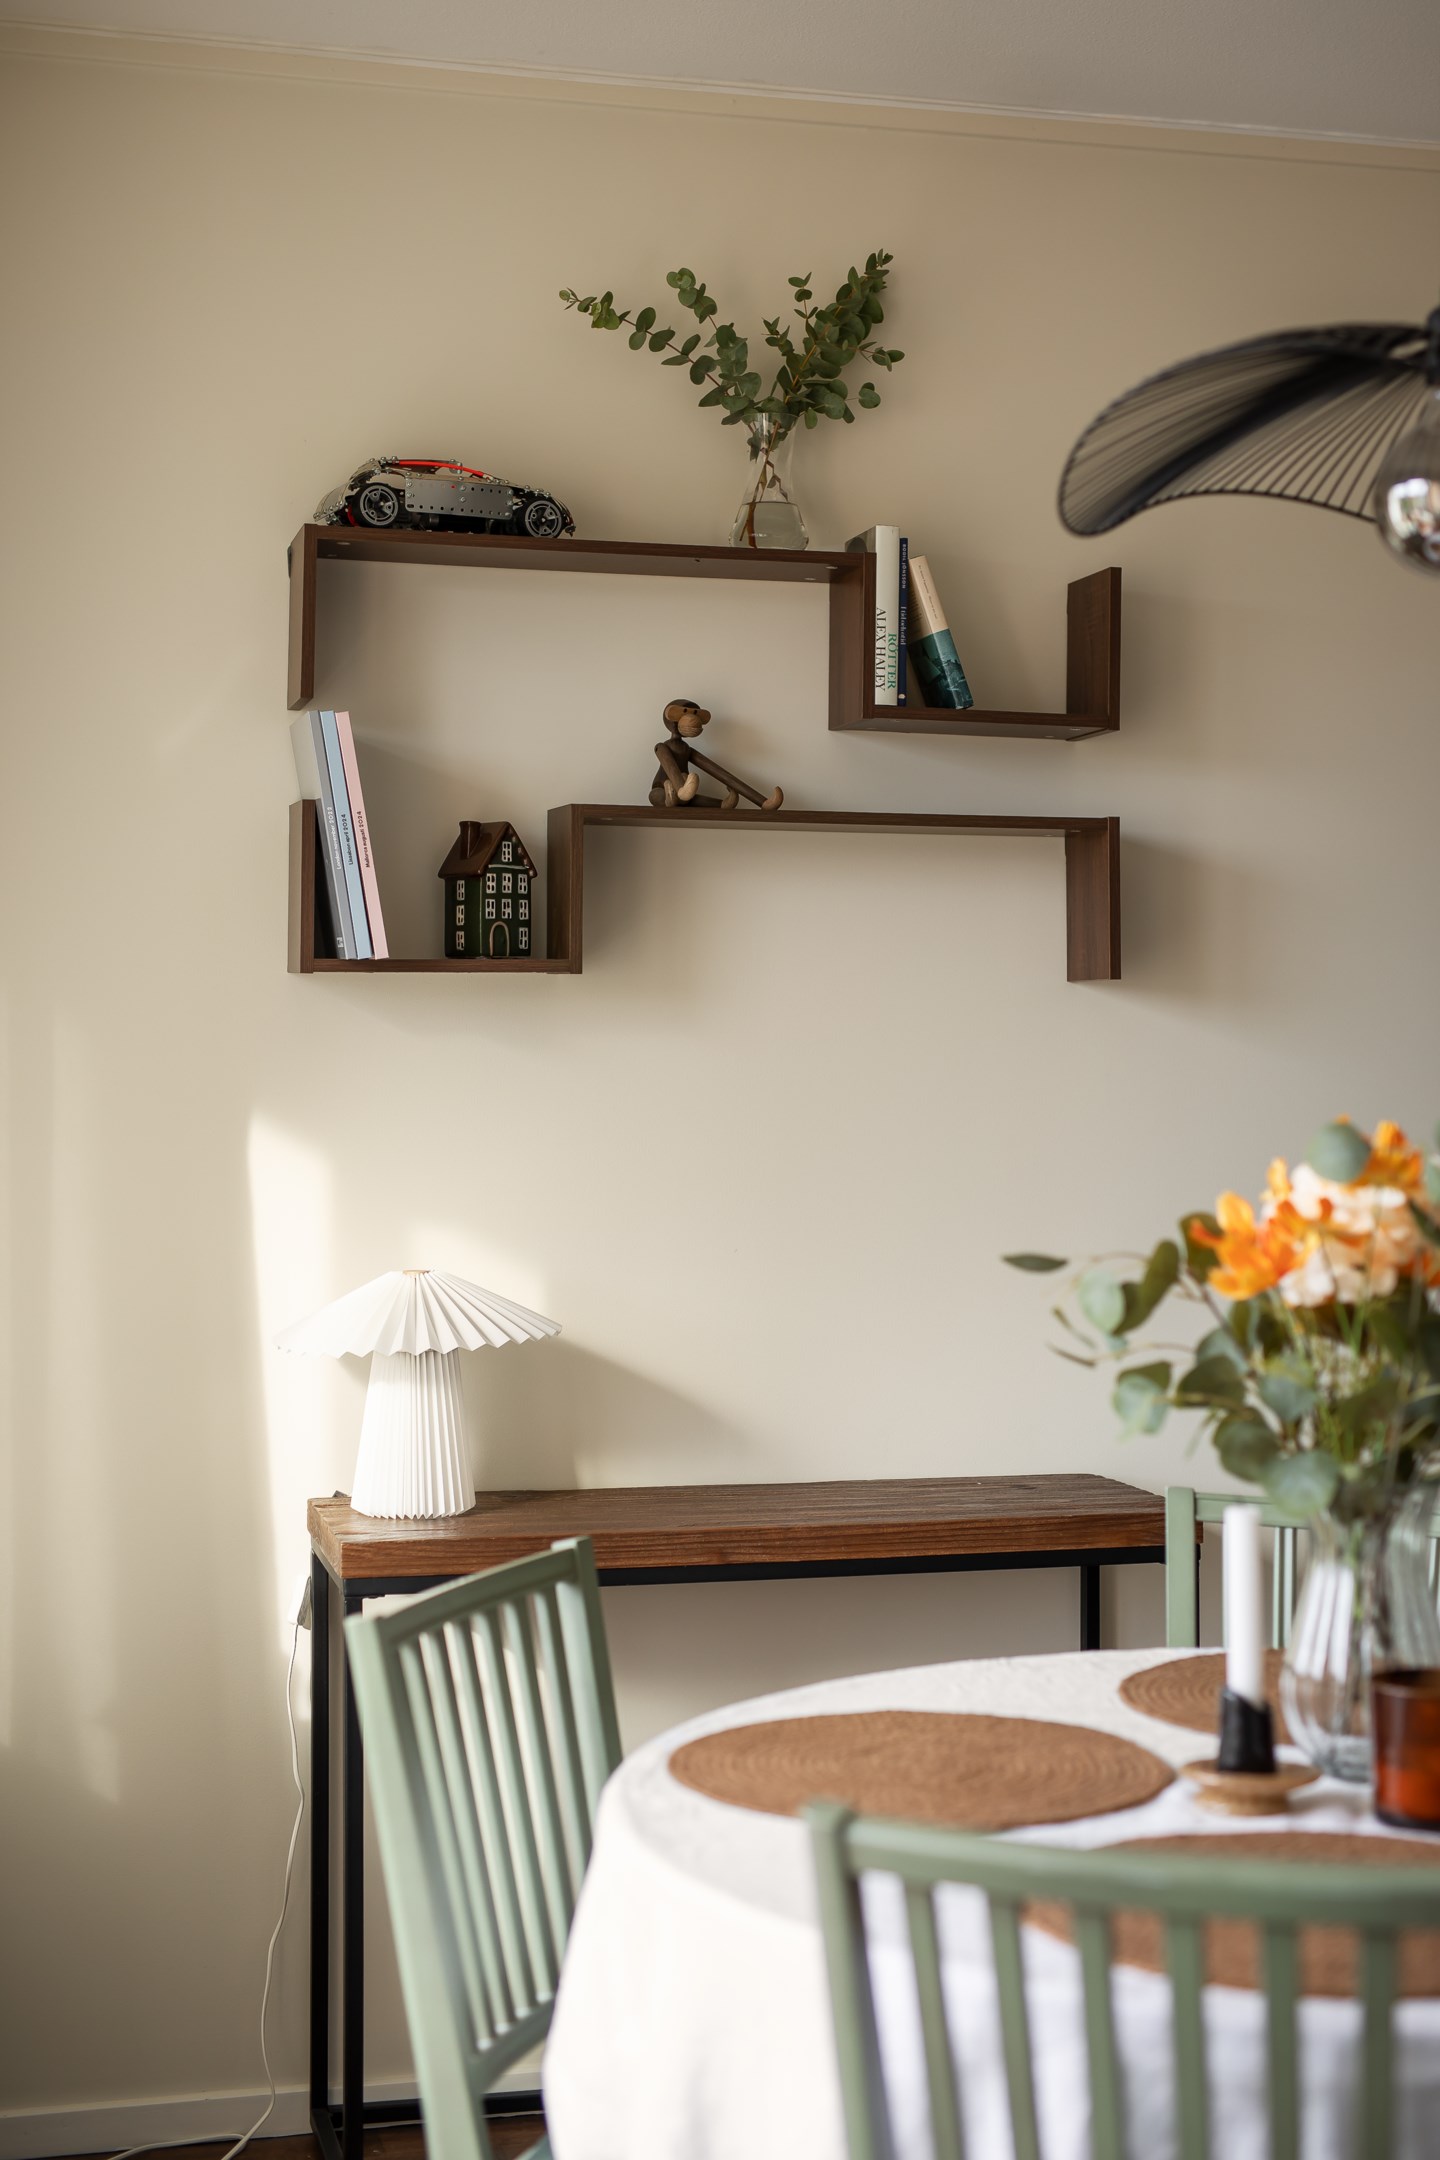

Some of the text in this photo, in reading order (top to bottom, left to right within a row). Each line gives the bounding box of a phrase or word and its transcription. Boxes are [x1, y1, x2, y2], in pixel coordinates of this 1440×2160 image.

[875, 608, 886, 691] ALEX HALEY
[887, 633, 898, 689] RÖTTER
